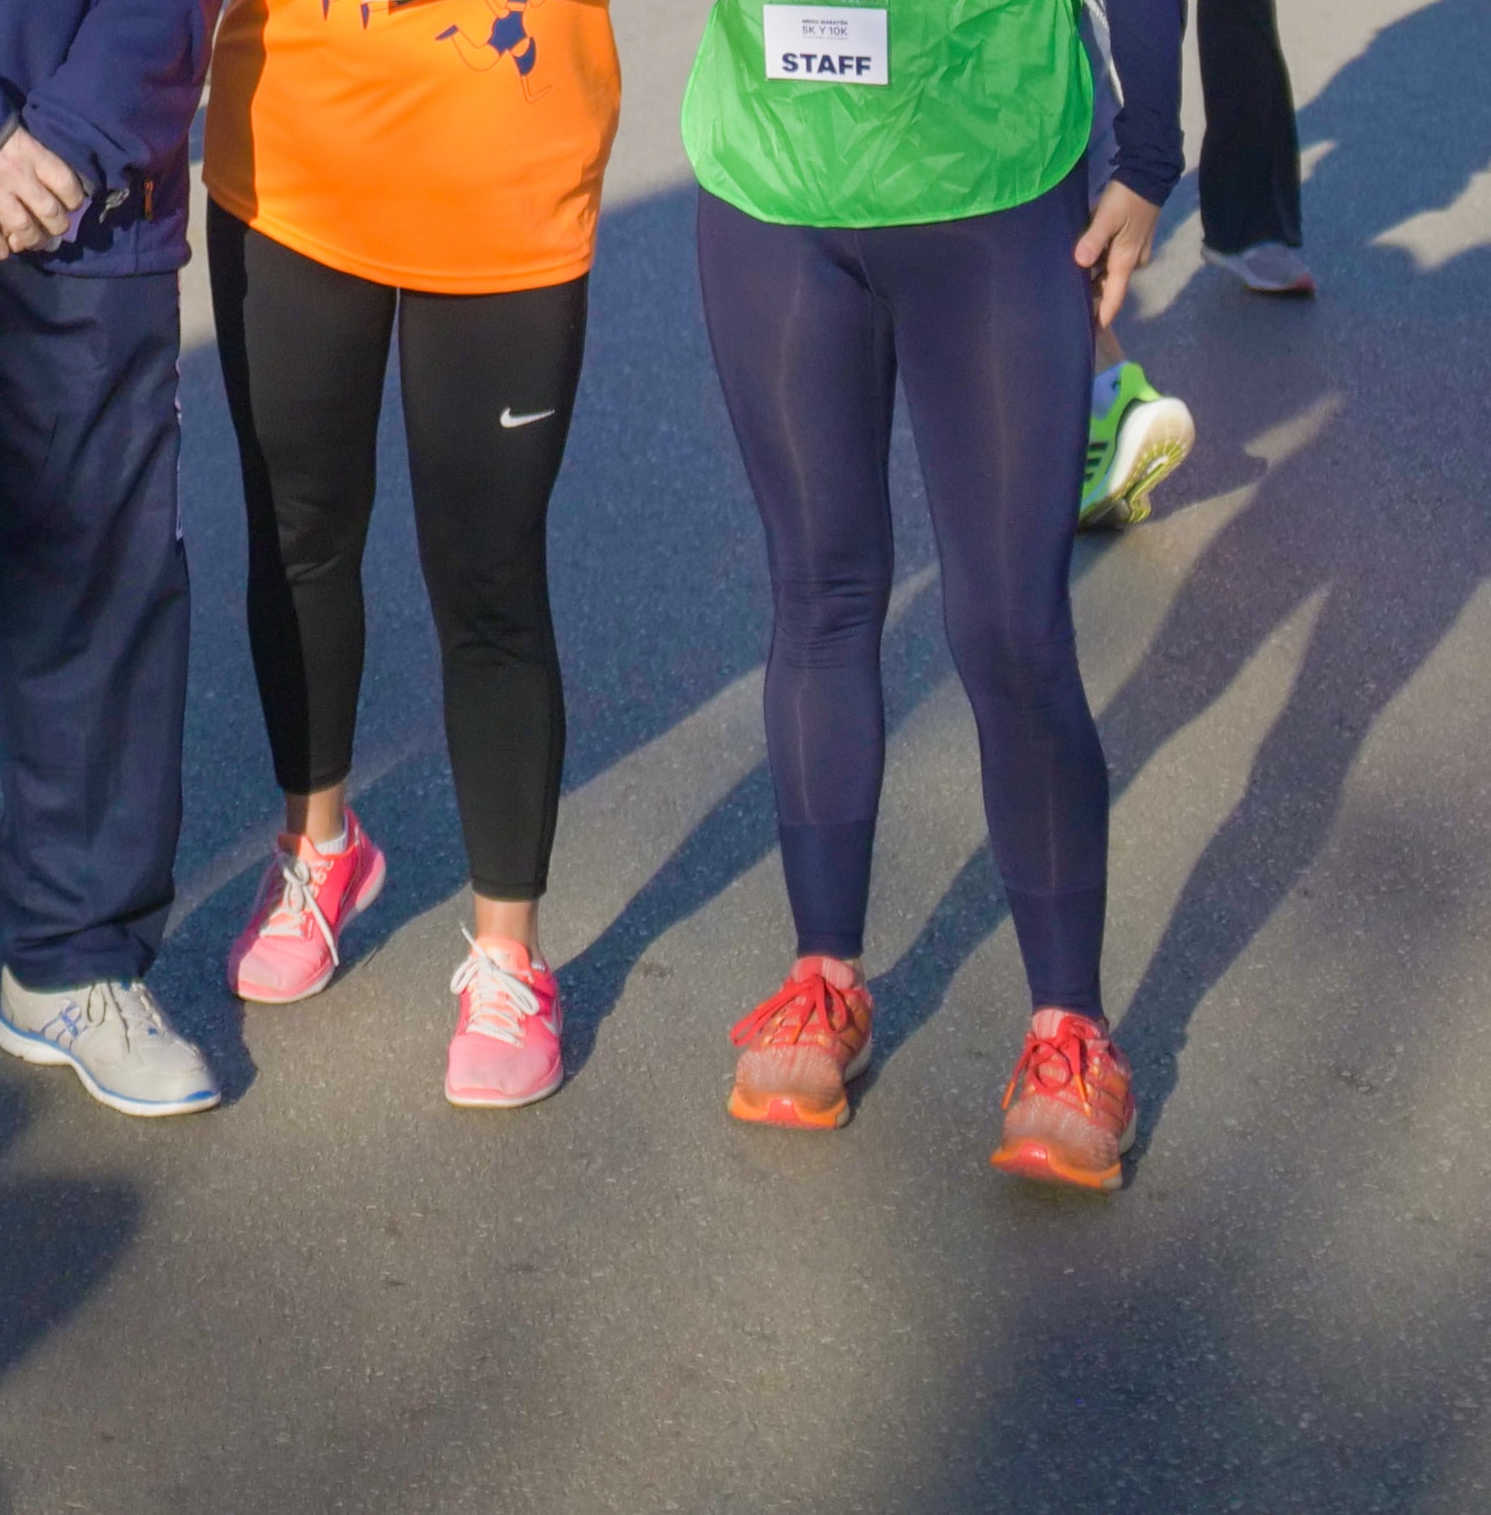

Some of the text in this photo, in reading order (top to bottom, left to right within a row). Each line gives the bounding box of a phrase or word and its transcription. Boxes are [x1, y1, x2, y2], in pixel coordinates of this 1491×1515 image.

[802, 25, 848, 36] 5K Y 10K
[782, 53, 872, 76] STAFF
